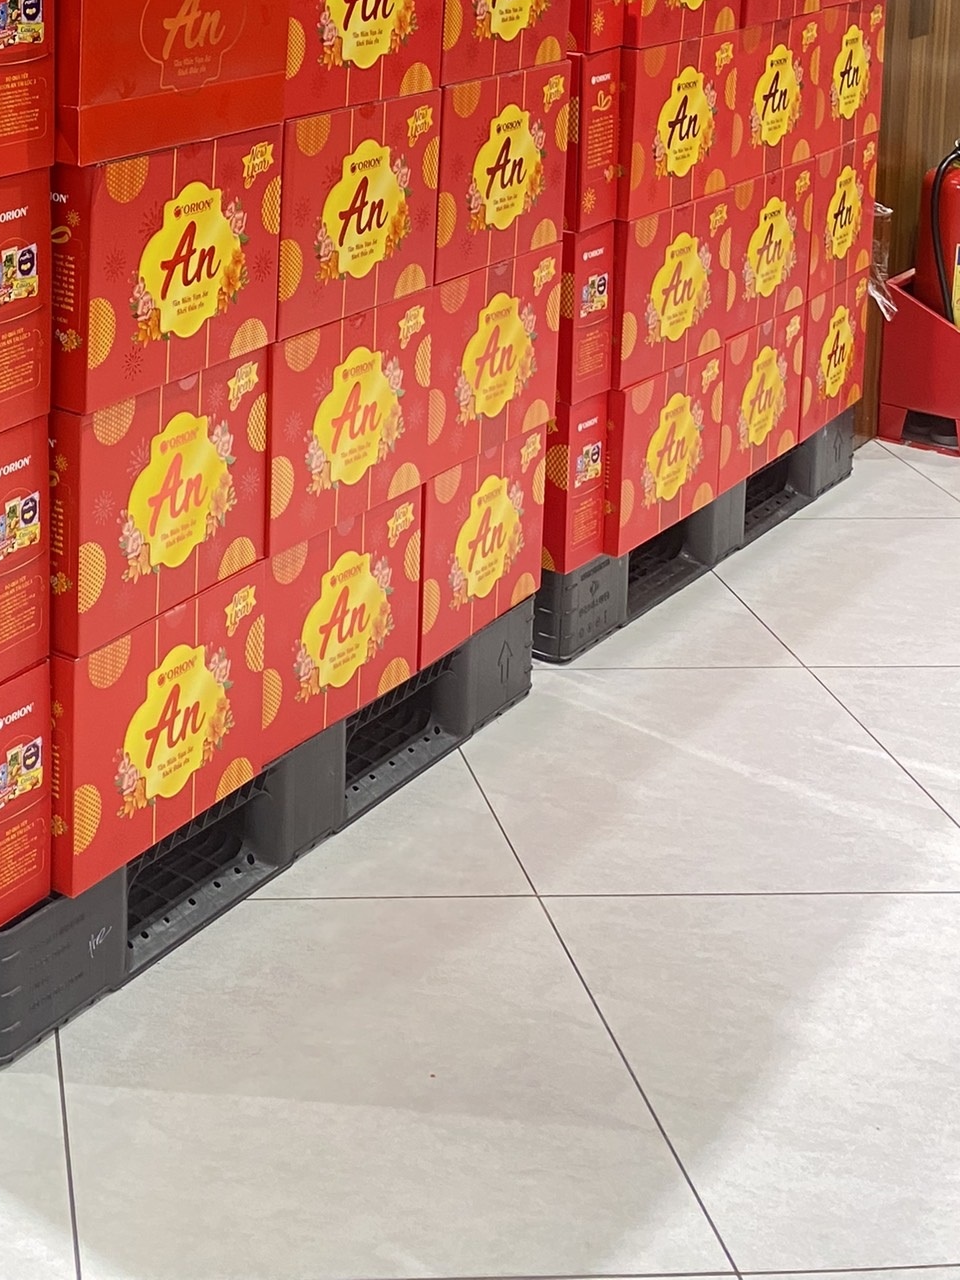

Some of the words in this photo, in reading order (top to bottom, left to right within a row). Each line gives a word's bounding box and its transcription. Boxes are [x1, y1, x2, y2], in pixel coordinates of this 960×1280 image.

[762, 71, 789, 120] An
[839, 49, 861, 94] An
[668, 95, 700, 149] An
[250, 147, 268, 164] New
[358, 157, 381, 173] ORION
[485, 136, 527, 200] An
[0, 208, 27, 223] ORION
[183, 199, 211, 215] ORION
[338, 176, 388, 247] An
[833, 191, 854, 237] An
[160, 221, 221, 300] An
[756, 223, 784, 274] An
[661, 260, 695, 316] An
[475, 325, 516, 389] An
[827, 329, 846, 377] An
[331, 382, 381, 454] An
[750, 374, 775, 425] An
[2, 457, 30, 475] ORION
[656, 421, 689, 477] An
[148, 453, 208, 537] An
[468, 506, 506, 572] An
[319, 585, 370, 660] An
[166, 659, 195, 681] ORION
[5, 704, 33, 723] ORION
[145, 683, 206, 769] An
